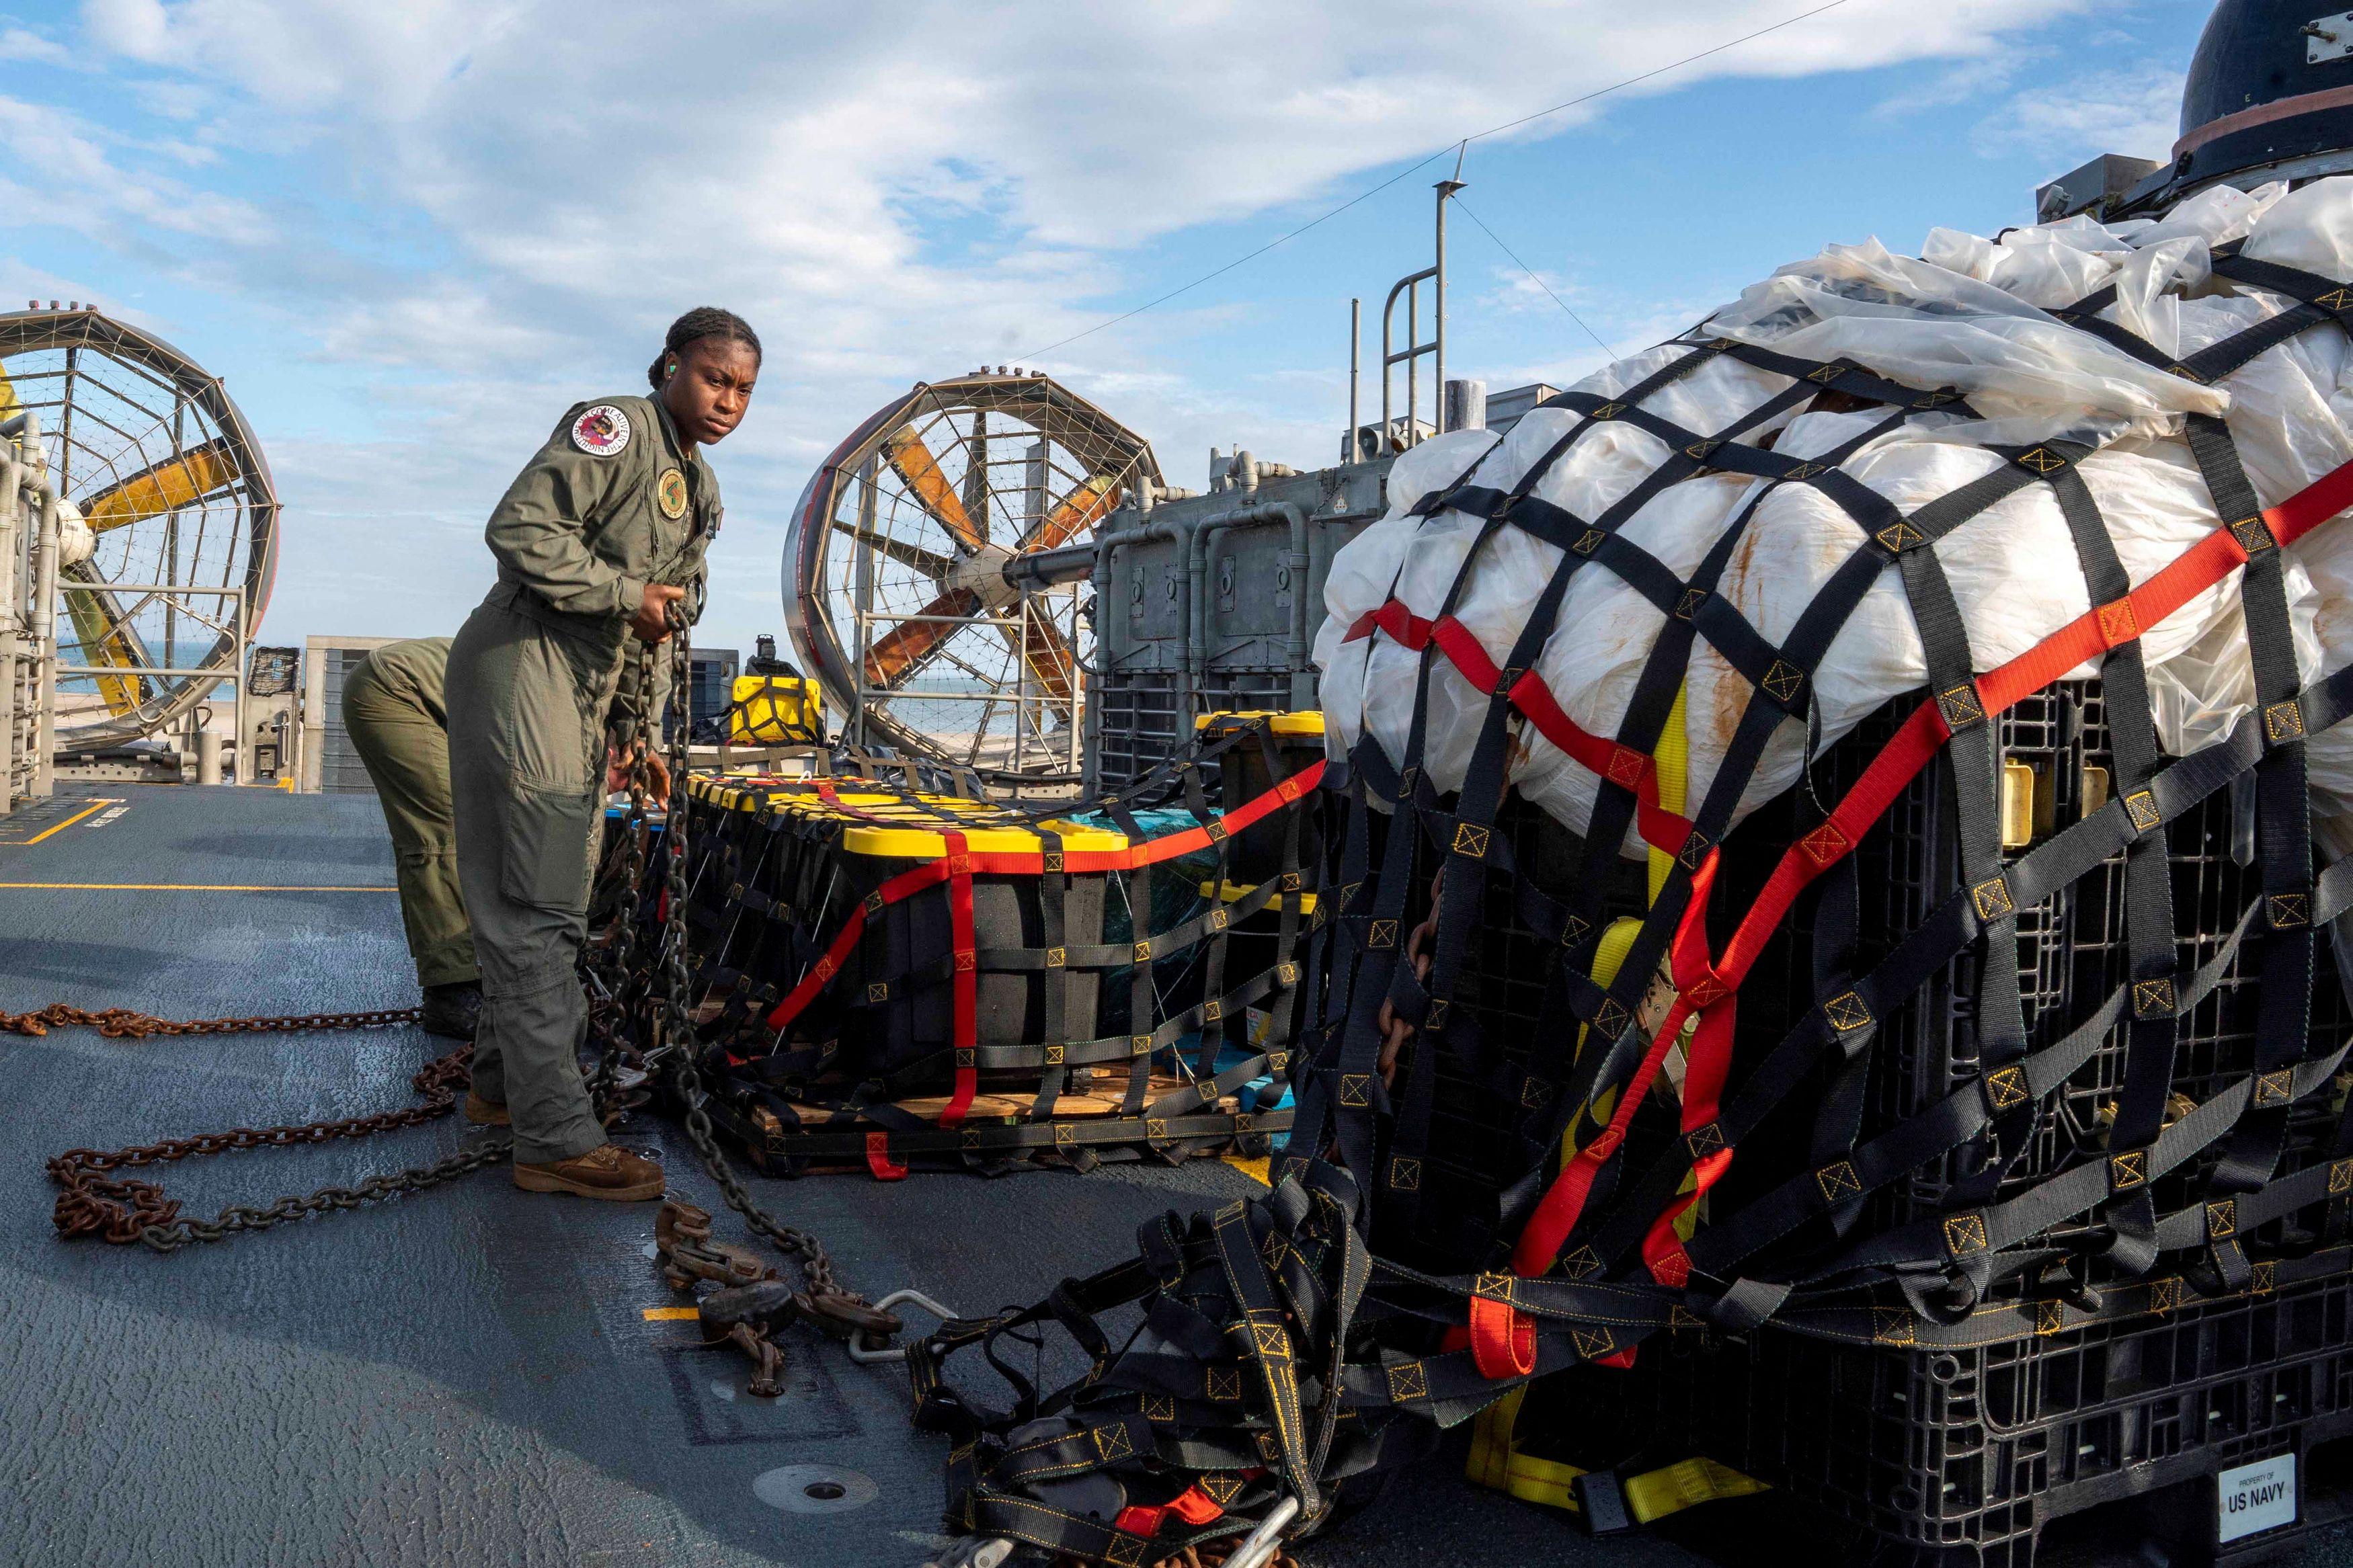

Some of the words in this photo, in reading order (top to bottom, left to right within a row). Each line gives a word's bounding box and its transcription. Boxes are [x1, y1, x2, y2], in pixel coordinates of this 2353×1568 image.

[2245, 93, 2251, 102] E
[614, 413, 628, 434] ALIVE
[618, 435, 627, 444] IN
[606, 443, 622, 452] THE
[2239, 1474, 2266, 1487] PROPERTY
[2267, 1471, 2274, 1480] OF
[2229, 1493, 2247, 1513] US
[2251, 1481, 2284, 1507] NAVY
